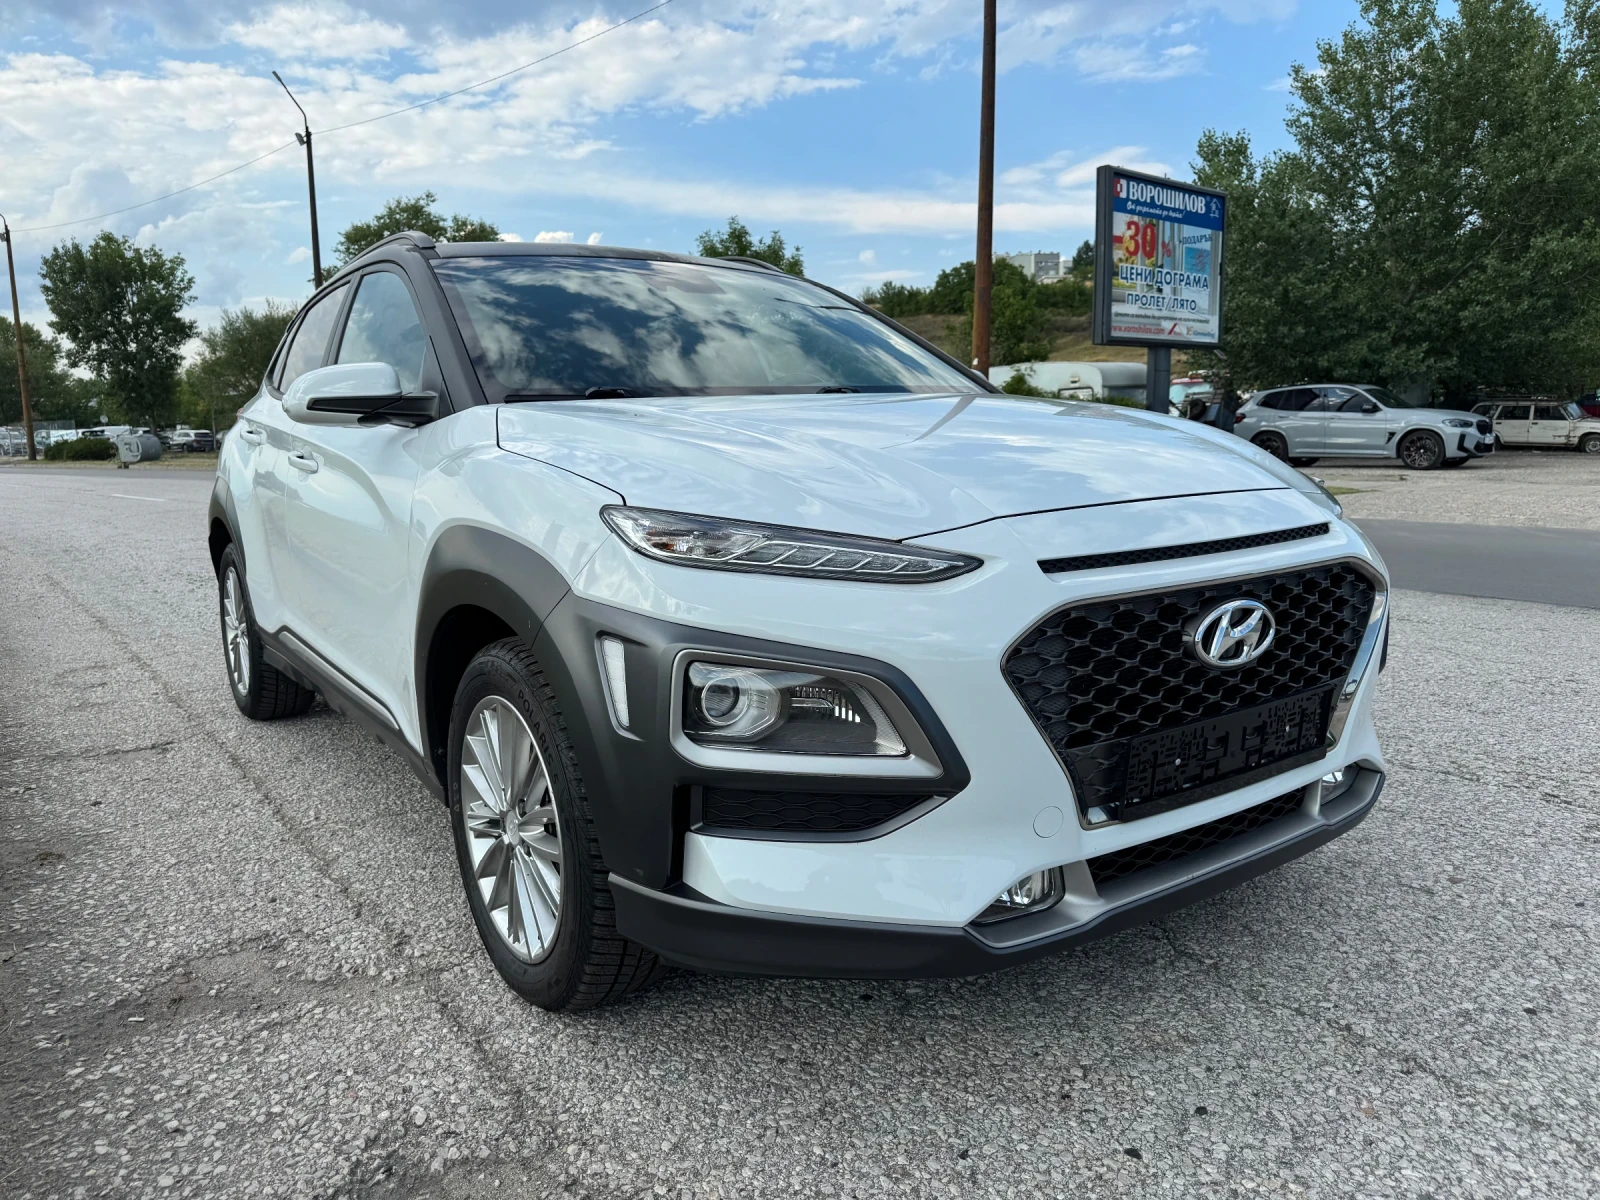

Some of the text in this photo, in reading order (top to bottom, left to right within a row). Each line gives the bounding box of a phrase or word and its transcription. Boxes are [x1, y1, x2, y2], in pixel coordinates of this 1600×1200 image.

[1129, 181, 1206, 214] ВОРОШИЛОВ
[1120, 265, 1209, 290] ЦЕНИ ДОГРАМА
[1127, 293, 1197, 311] ПРОЛЕТ/ЛЯТО
[518, 689, 554, 767] POLARIS
